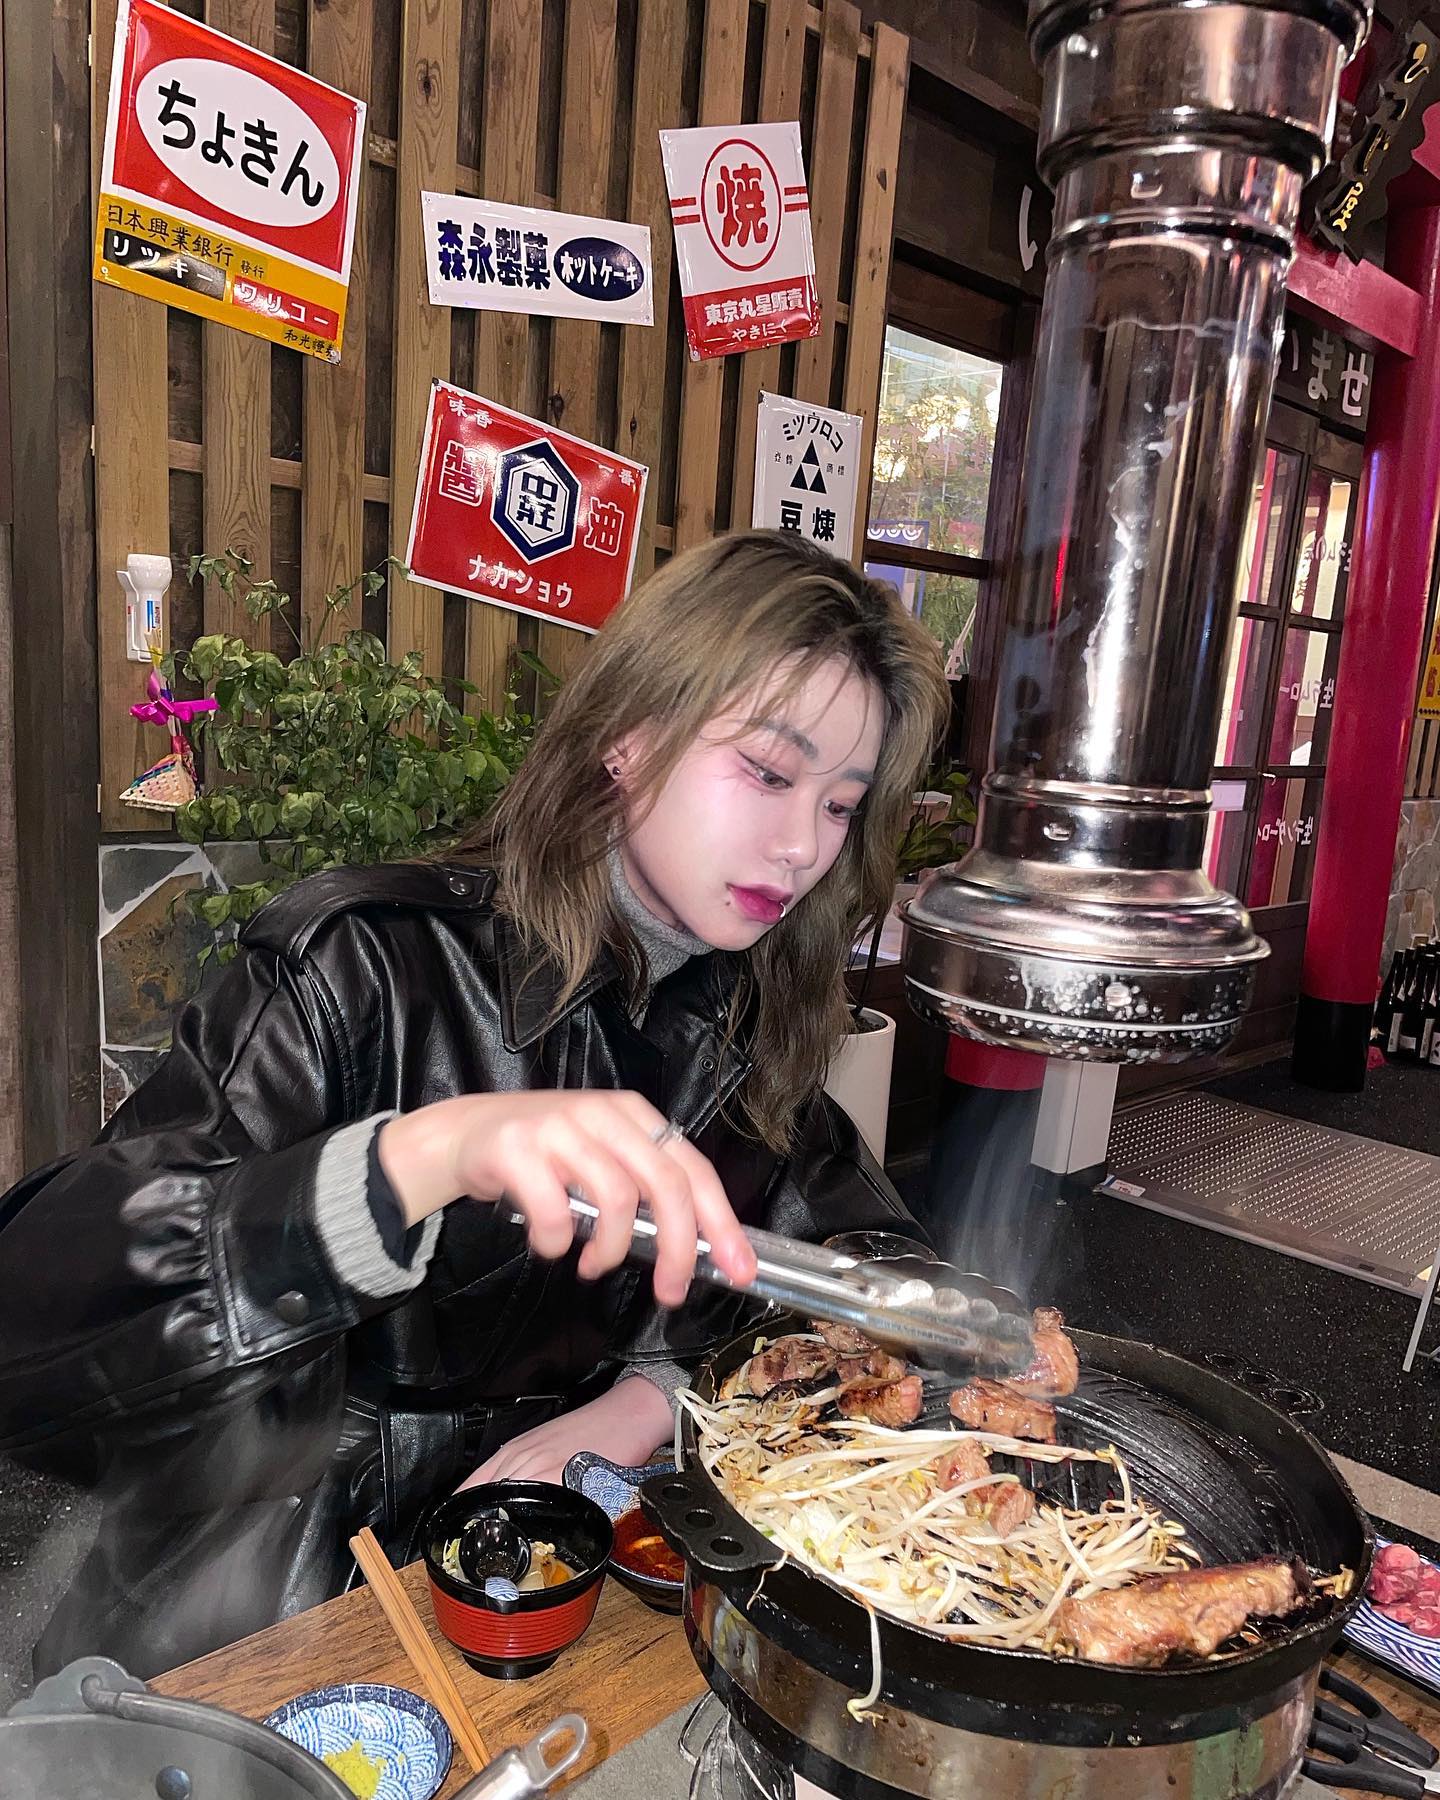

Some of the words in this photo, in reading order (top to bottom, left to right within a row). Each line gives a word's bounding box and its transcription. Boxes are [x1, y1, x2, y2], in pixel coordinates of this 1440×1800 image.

[157, 79, 325, 207] ちょきん
[106, 204, 234, 267] 日本興業銀行
[716, 163, 768, 247] 焼
[437, 219, 551, 290] 森永製菓
[732, 319, 787, 342] やきにく
[783, 412, 844, 453] ミツウロコ
